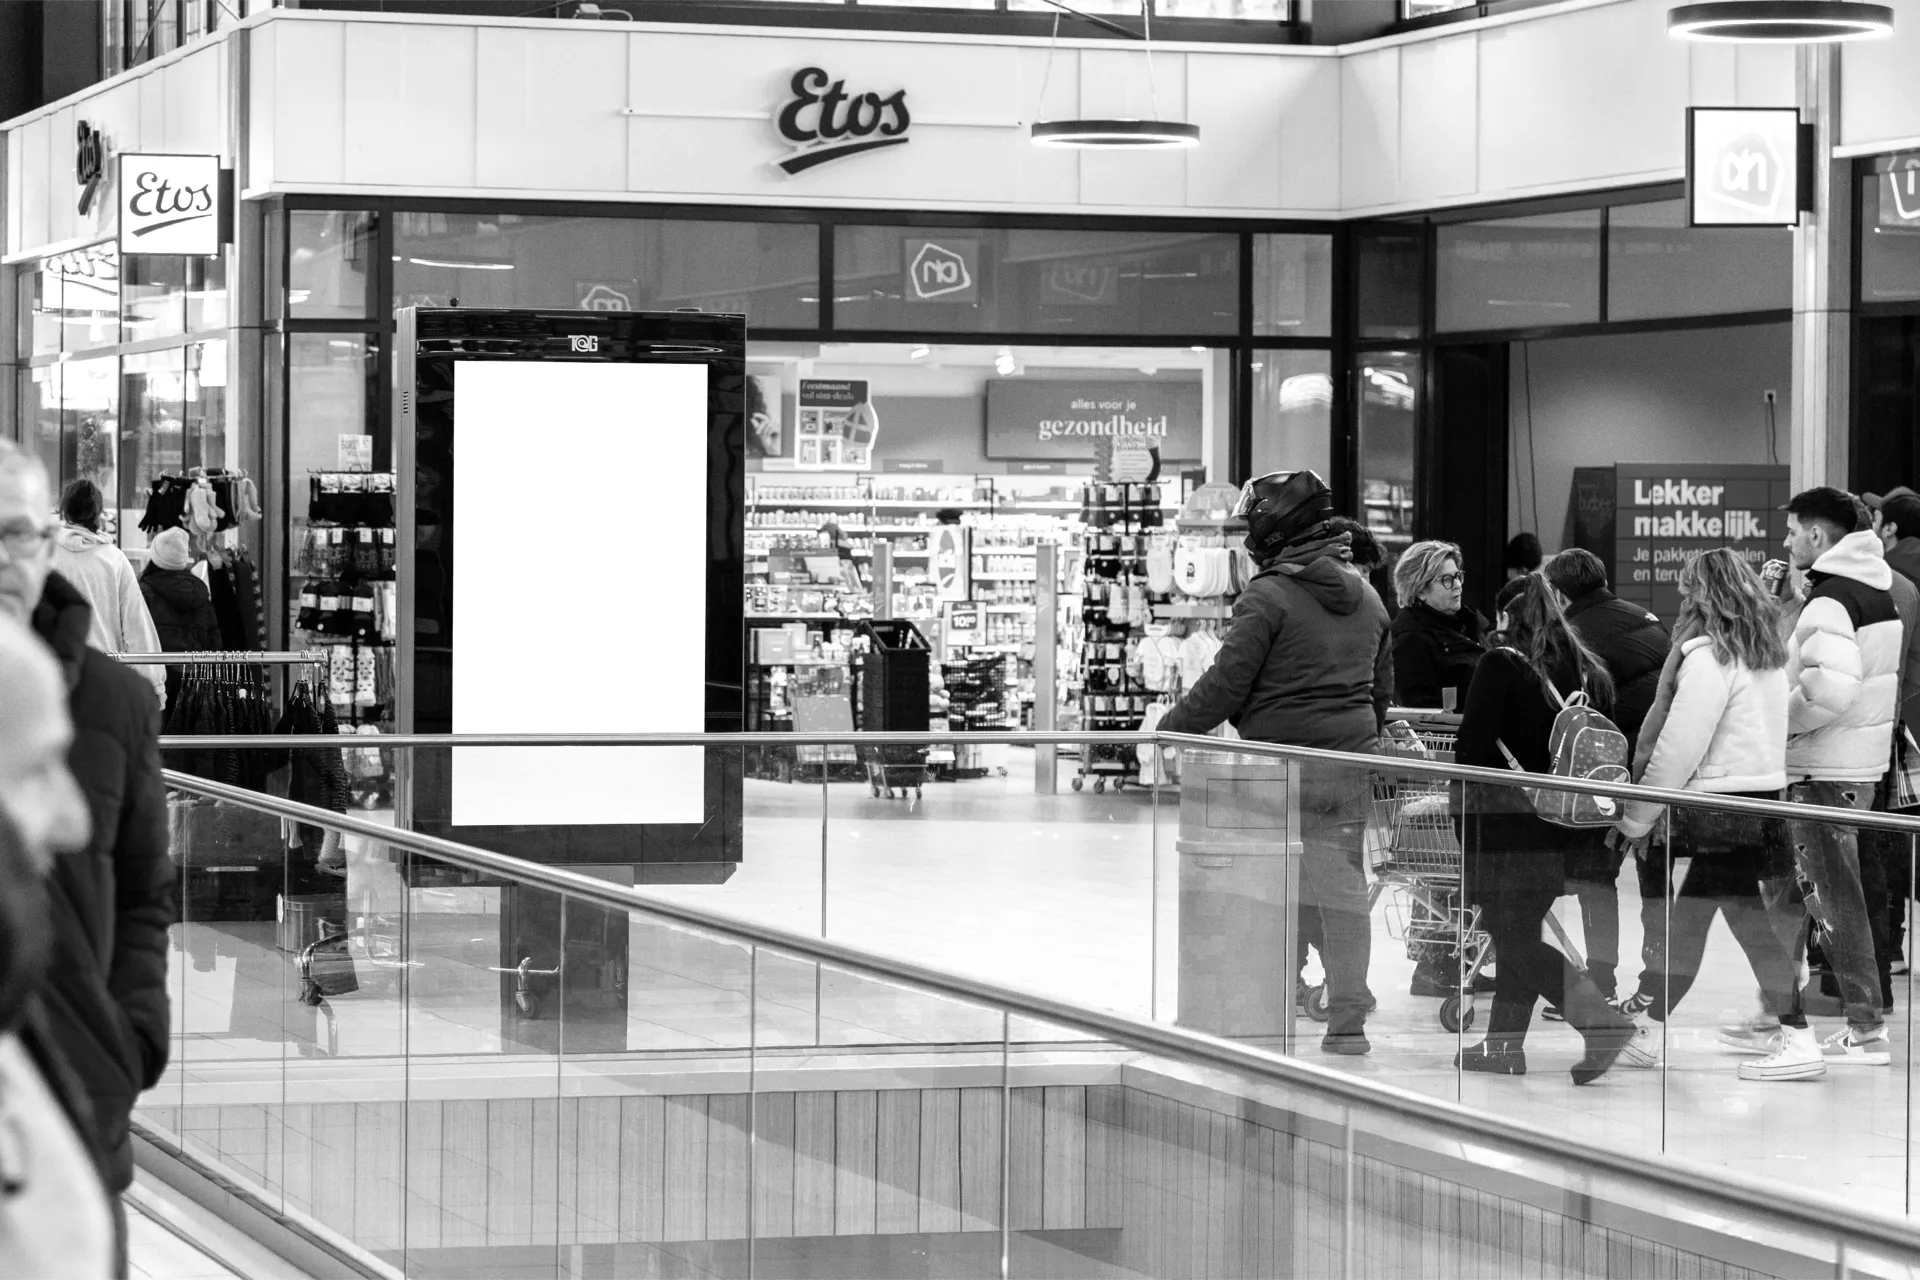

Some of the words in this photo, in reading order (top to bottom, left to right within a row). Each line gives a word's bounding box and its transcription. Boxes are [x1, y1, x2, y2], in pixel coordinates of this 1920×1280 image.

[778, 66, 911, 141] Etos
[129, 172, 212, 217] Etos
[1070, 398, 1096, 410] alles
[1098, 401, 1123, 410] voor
[1125, 399, 1137, 412] je
[1038, 415, 1168, 441] gezondheid
[1635, 479, 1724, 506] Lekker
[1634, 510, 1766, 542] makkelijk.
[1633, 547, 1650, 562] Je
[1654, 547, 1703, 565] pakket
[1633, 569, 1651, 582] en
[1655, 567, 1683, 582] teru
